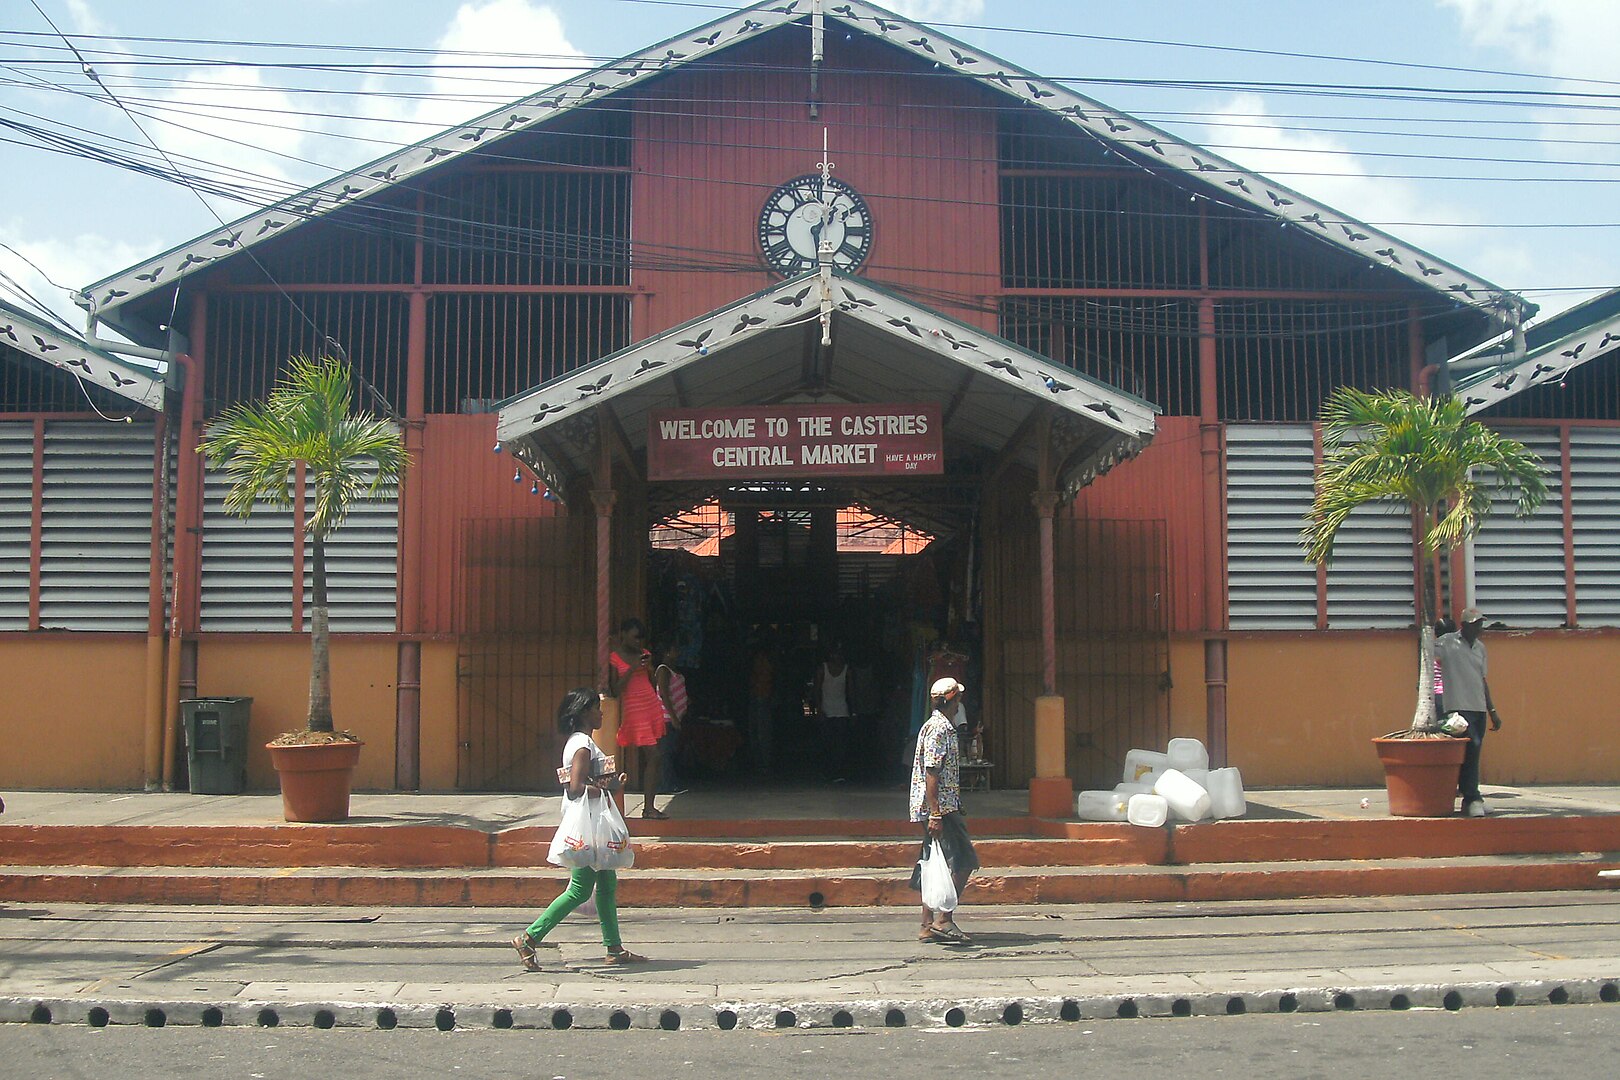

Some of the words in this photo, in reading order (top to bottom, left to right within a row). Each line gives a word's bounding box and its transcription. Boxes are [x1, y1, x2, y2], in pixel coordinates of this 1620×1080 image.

[659, 418, 756, 440] WELCOME
[765, 417, 789, 438] TO
[797, 416, 833, 437] THE
[841, 414, 928, 436] CASTRIES
[712, 446, 794, 467] CENTRAL
[801, 443, 878, 465] MARKET
[886, 453, 904, 462] HAVE
[906, 453, 912, 462] A
[913, 453, 937, 461] HAPPY
[905, 462, 918, 470] DAY
